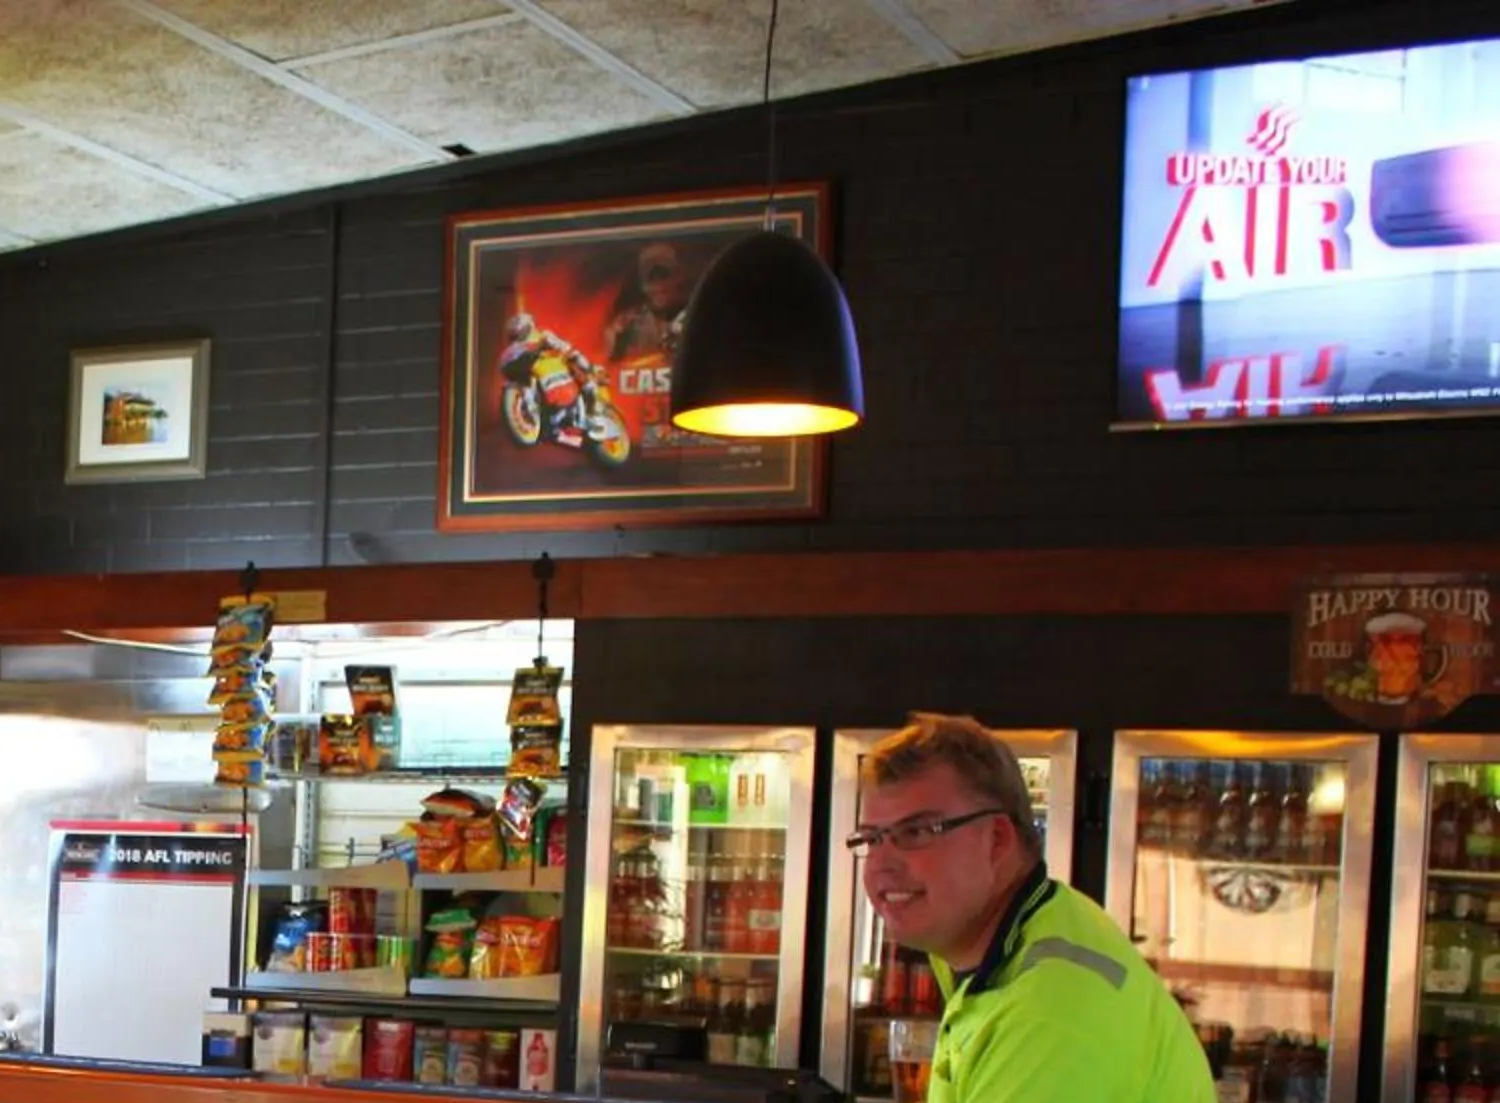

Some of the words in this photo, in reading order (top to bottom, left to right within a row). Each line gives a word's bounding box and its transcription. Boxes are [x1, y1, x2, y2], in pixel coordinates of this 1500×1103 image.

[1172, 156, 1280, 185] UPDATE
[1289, 156, 1348, 184] YOUR
[1147, 186, 1356, 288] AIR
[1307, 588, 1401, 628] HAPPY
[1409, 587, 1492, 626] HOUR
[143, 849, 171, 863] AFL
[173, 849, 233, 866] TIPPING
